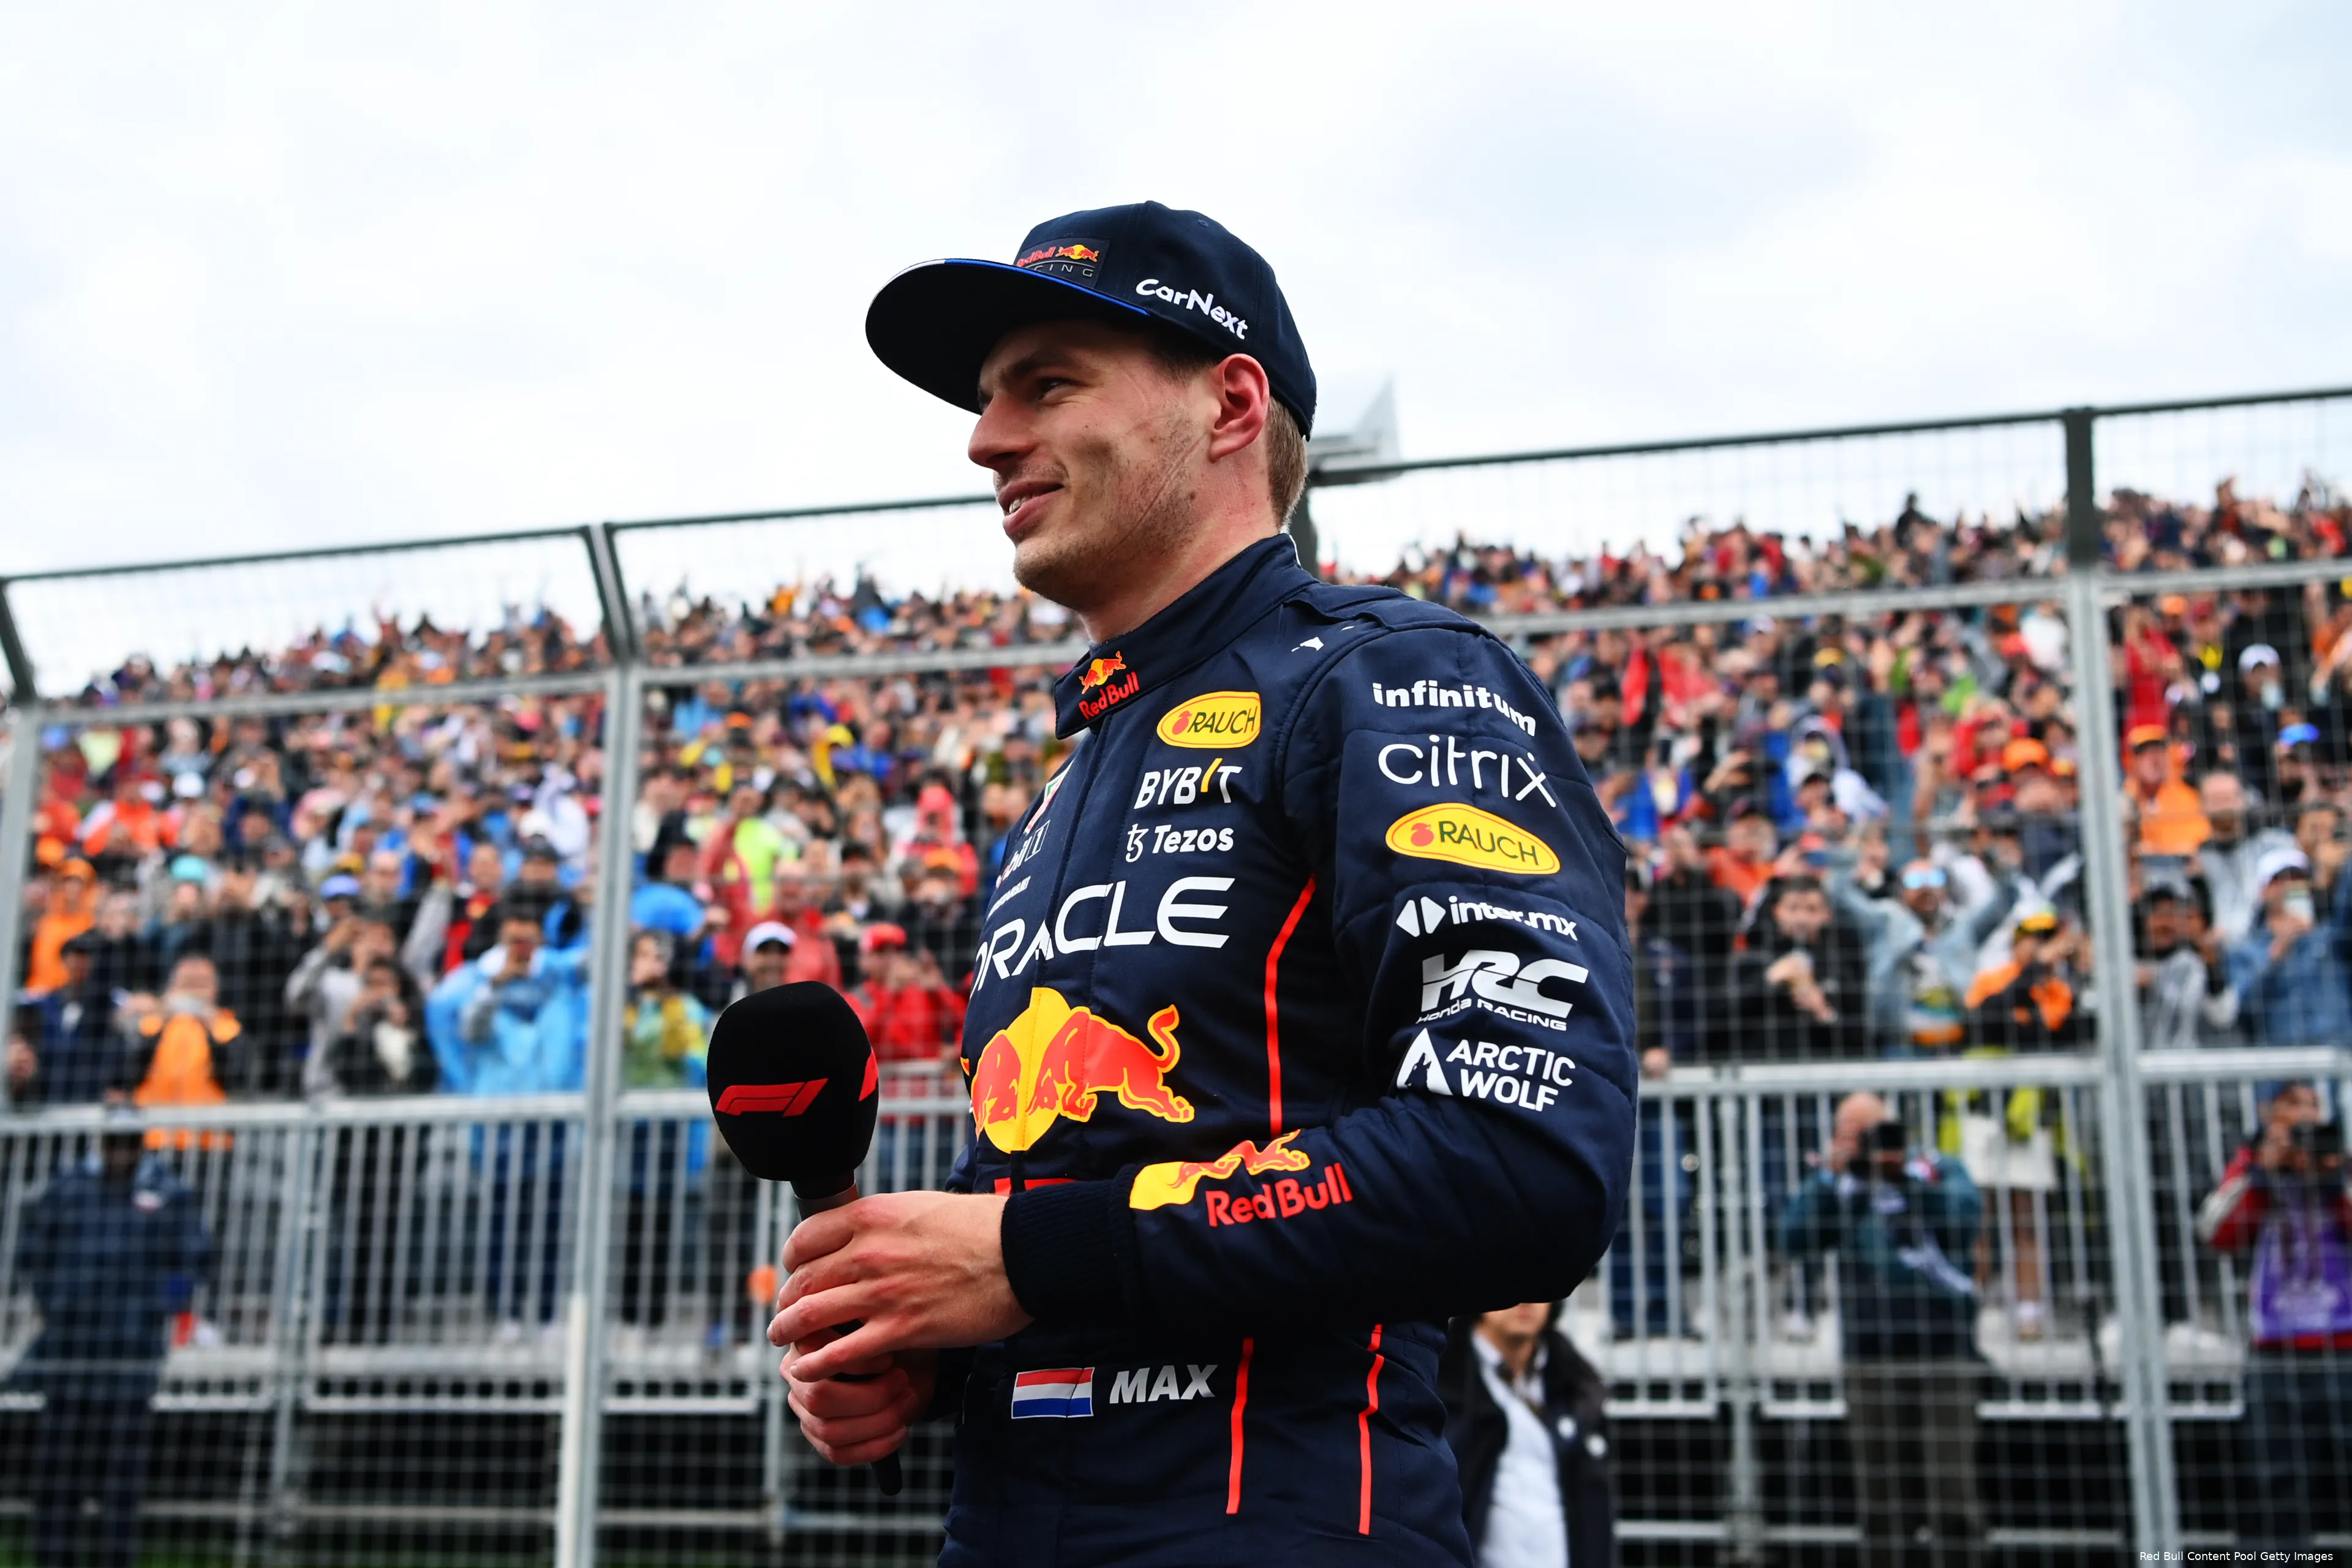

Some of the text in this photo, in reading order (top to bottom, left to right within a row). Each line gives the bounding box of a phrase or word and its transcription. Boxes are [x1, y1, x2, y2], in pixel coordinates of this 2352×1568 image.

[1136, 279, 1248, 340] CarNext
[1187, 709, 1257, 734] RAUCH
[1373, 679, 1536, 737] infinitum
[1133, 758, 1243, 810] BYBIT
[1378, 734, 1556, 808] citrix
[1152, 824, 1234, 854] Tezos
[1438, 820, 1540, 866] RAUCH
[1449, 895, 1578, 941] inter.mx
[1420, 949, 1589, 1019] HRC
[1477, 998, 1567, 1031] RACING
[1446, 1039, 1576, 1087] ARCTIC
[715, 1078, 829, 1117] F1
[1460, 1068, 1559, 1112] WOLF
[1109, 1365, 1218, 1404] MAX
